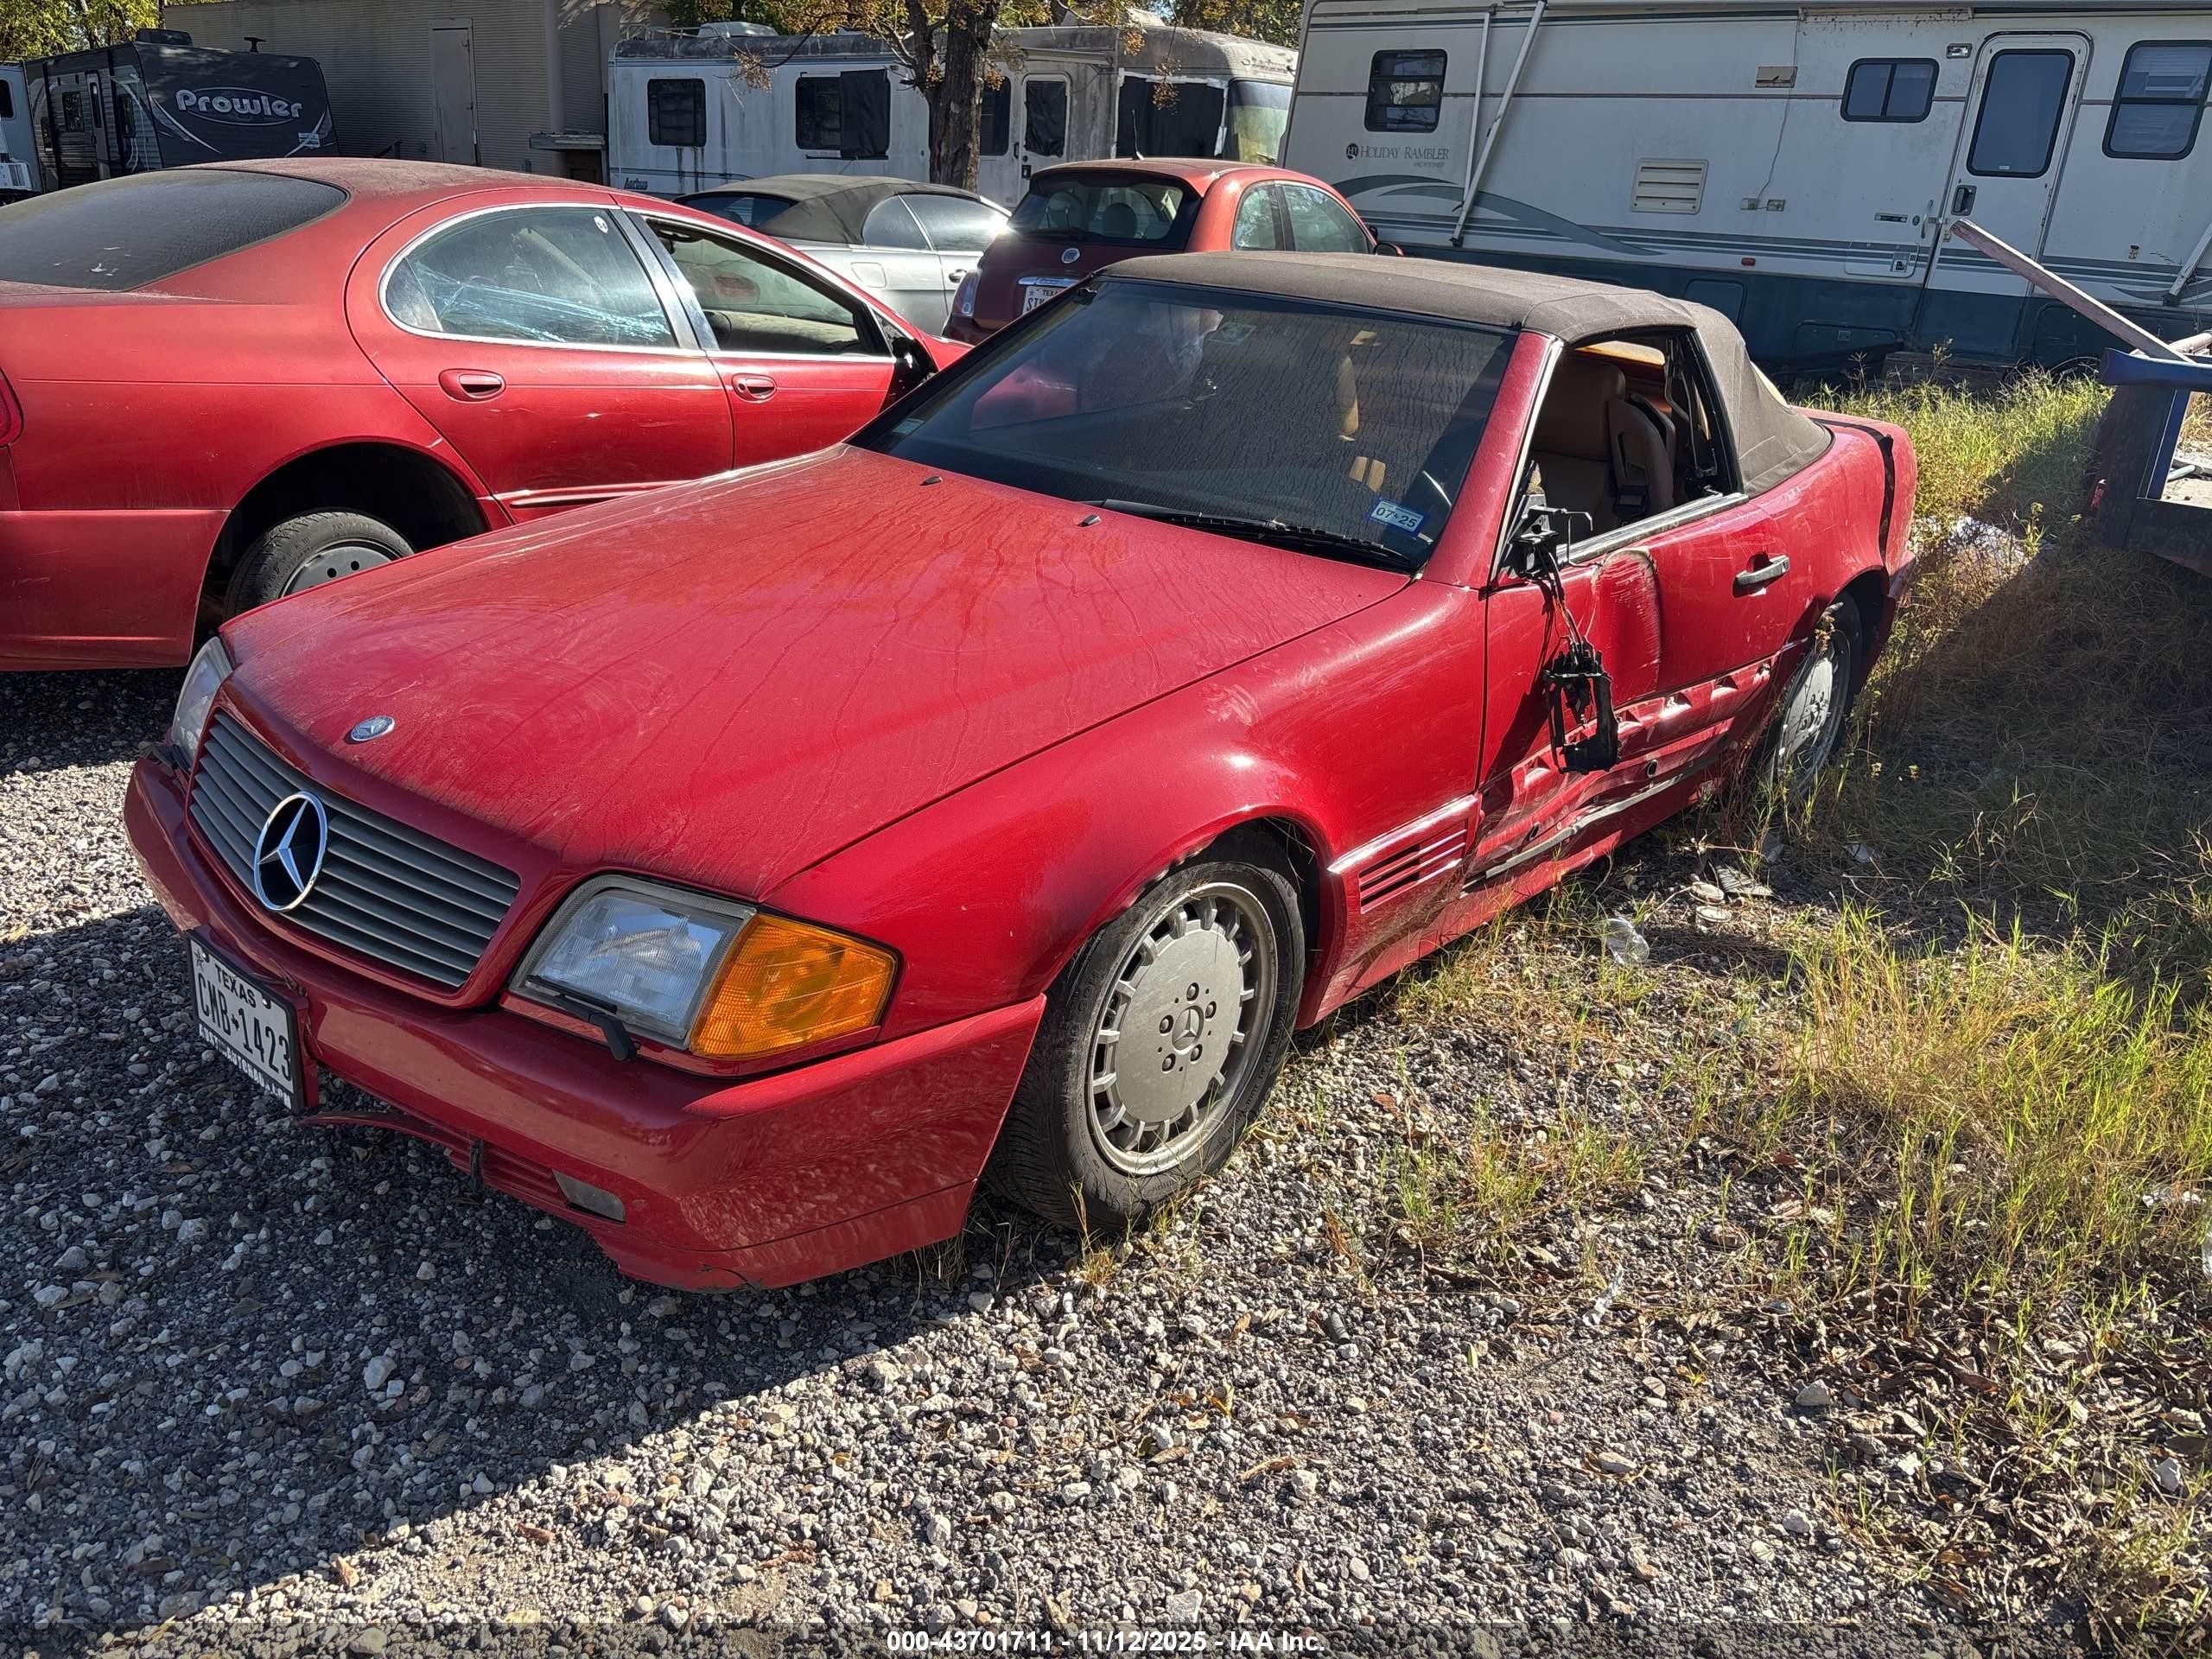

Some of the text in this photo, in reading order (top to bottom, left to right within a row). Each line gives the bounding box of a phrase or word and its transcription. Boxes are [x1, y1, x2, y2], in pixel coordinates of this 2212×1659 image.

[175, 89, 302, 118] Prowler
[1361, 145, 1450, 160] HOLIDAY RAMBLER
[1376, 507, 1395, 518] 07
[1398, 515, 1417, 528] 25
[215, 963, 257, 1008] TEXAS
